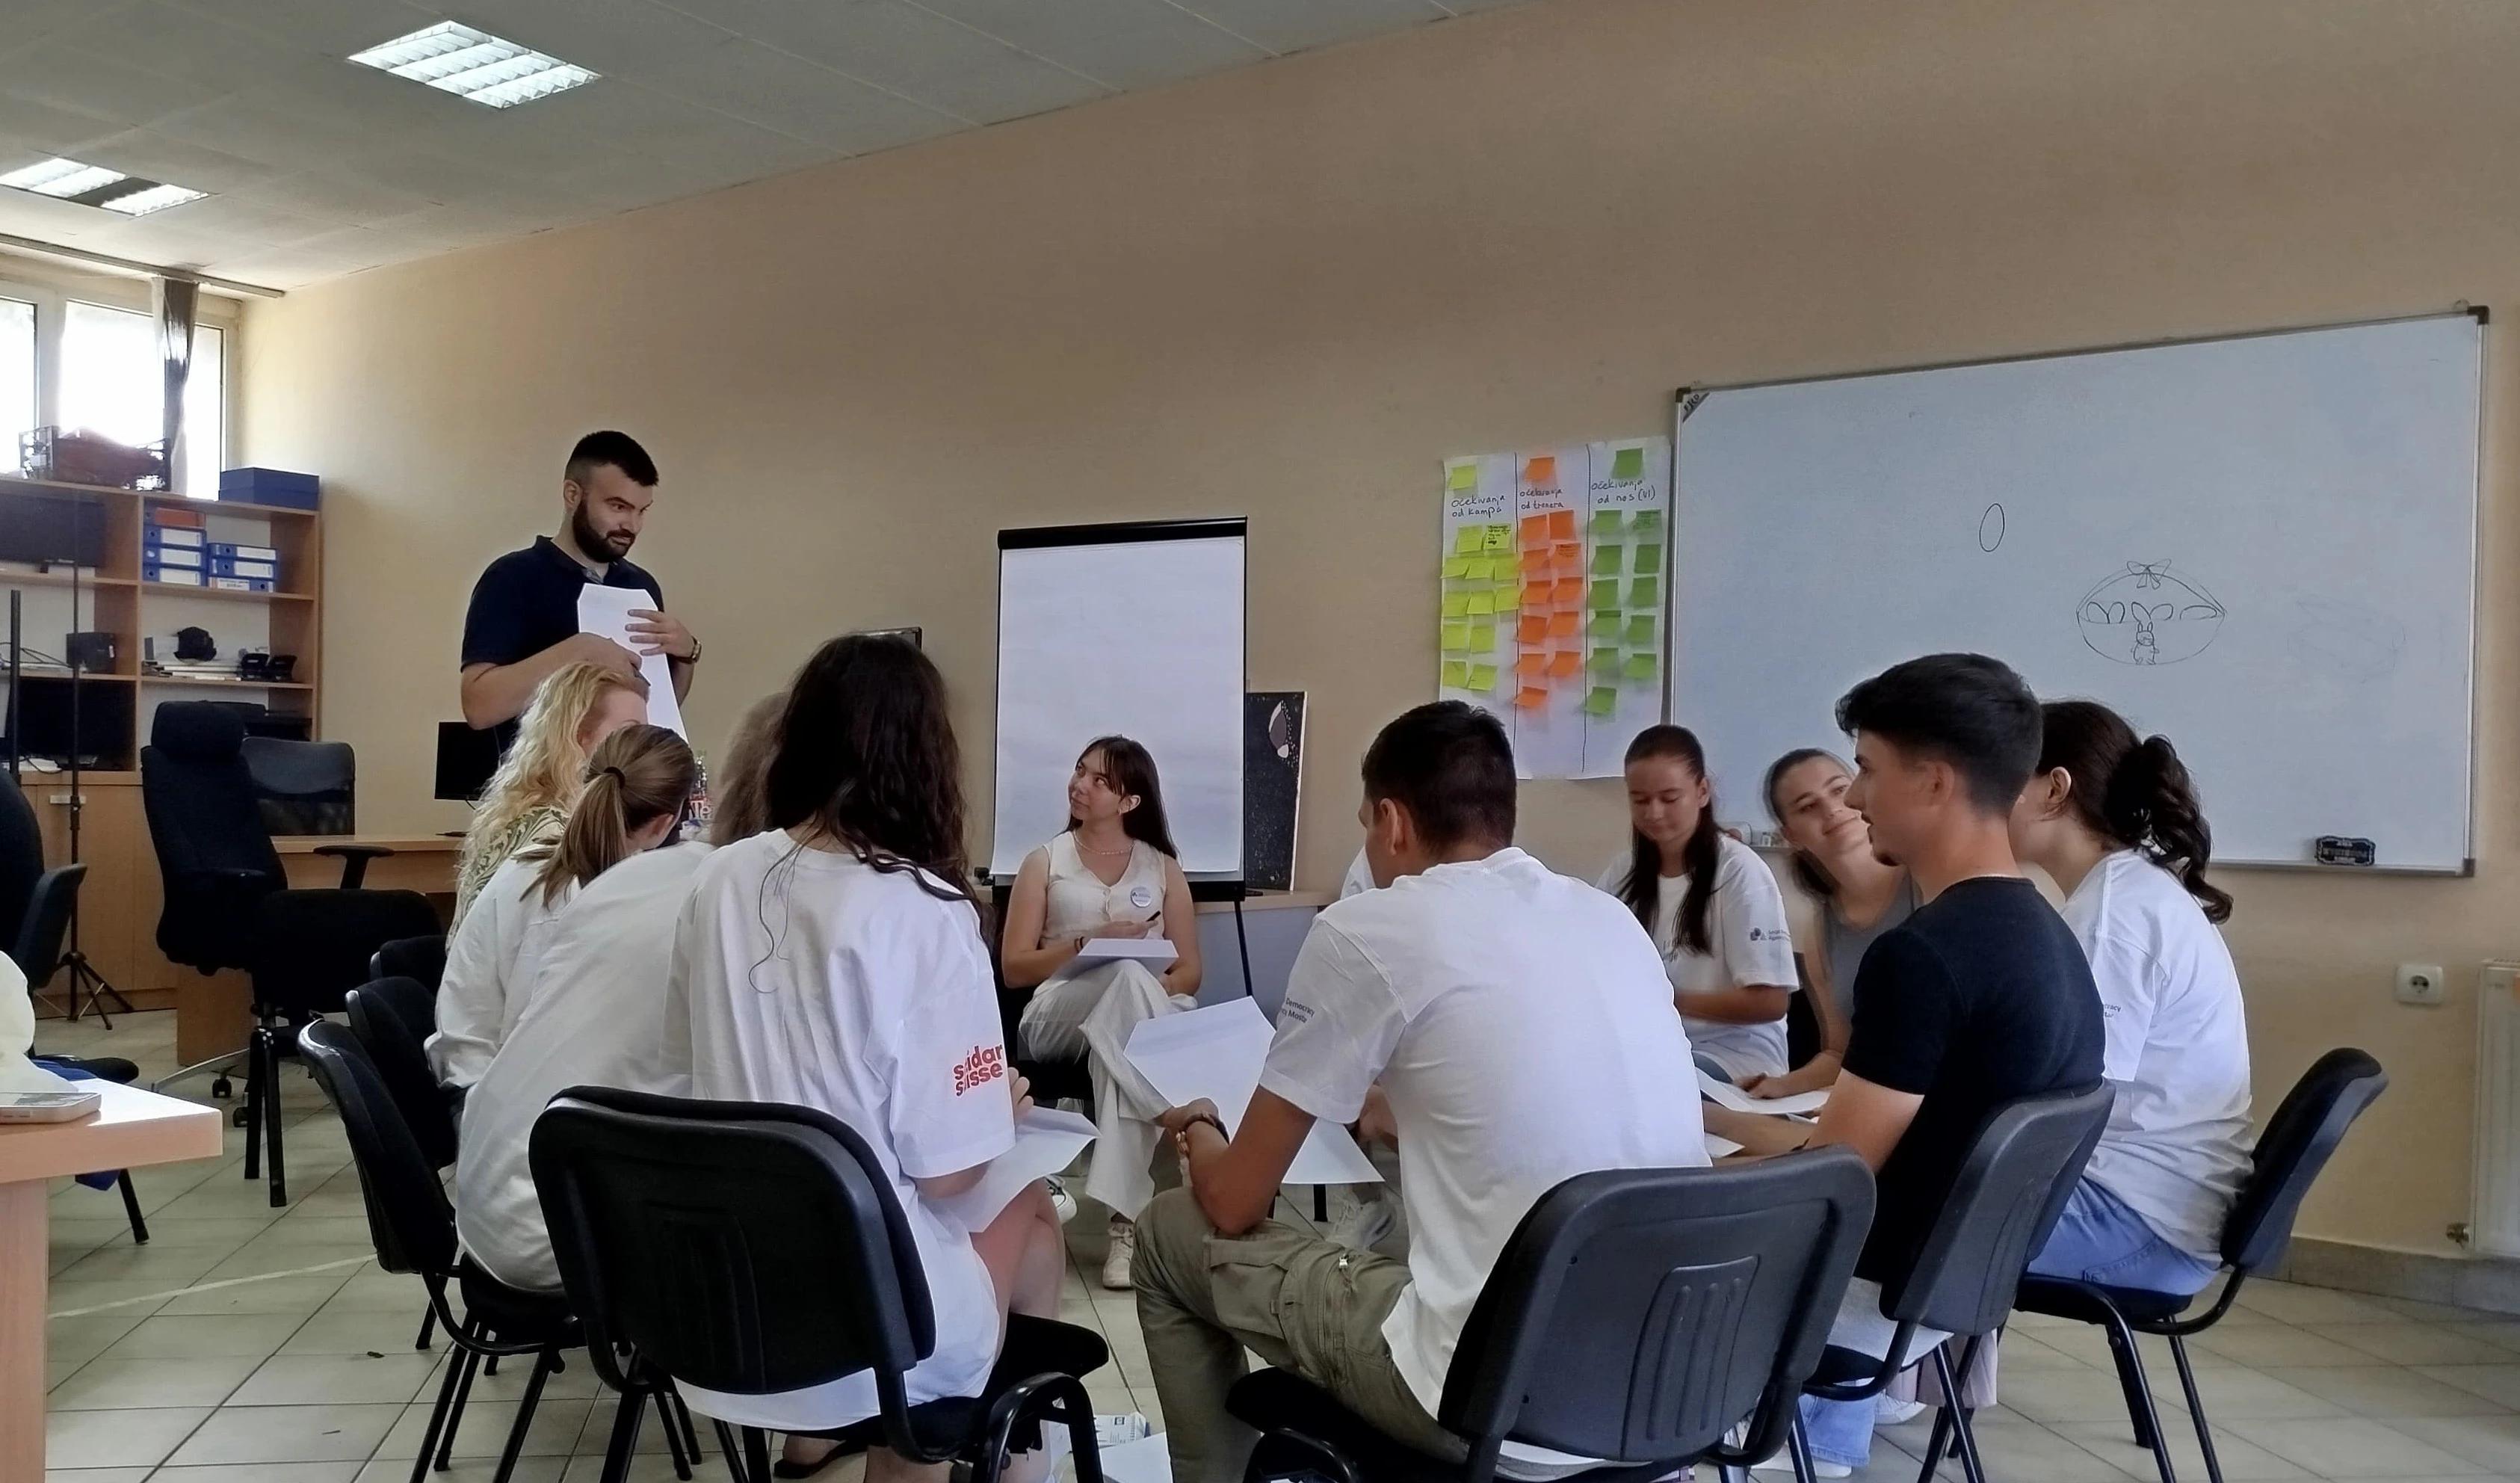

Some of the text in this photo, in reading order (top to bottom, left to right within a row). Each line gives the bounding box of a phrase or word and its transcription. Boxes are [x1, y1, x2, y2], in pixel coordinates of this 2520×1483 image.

[1597, 494, 1610, 504] od
[1521, 501, 1531, 510] od
[1452, 508, 1464, 517] od
[956, 1063, 1003, 1097] sisse
